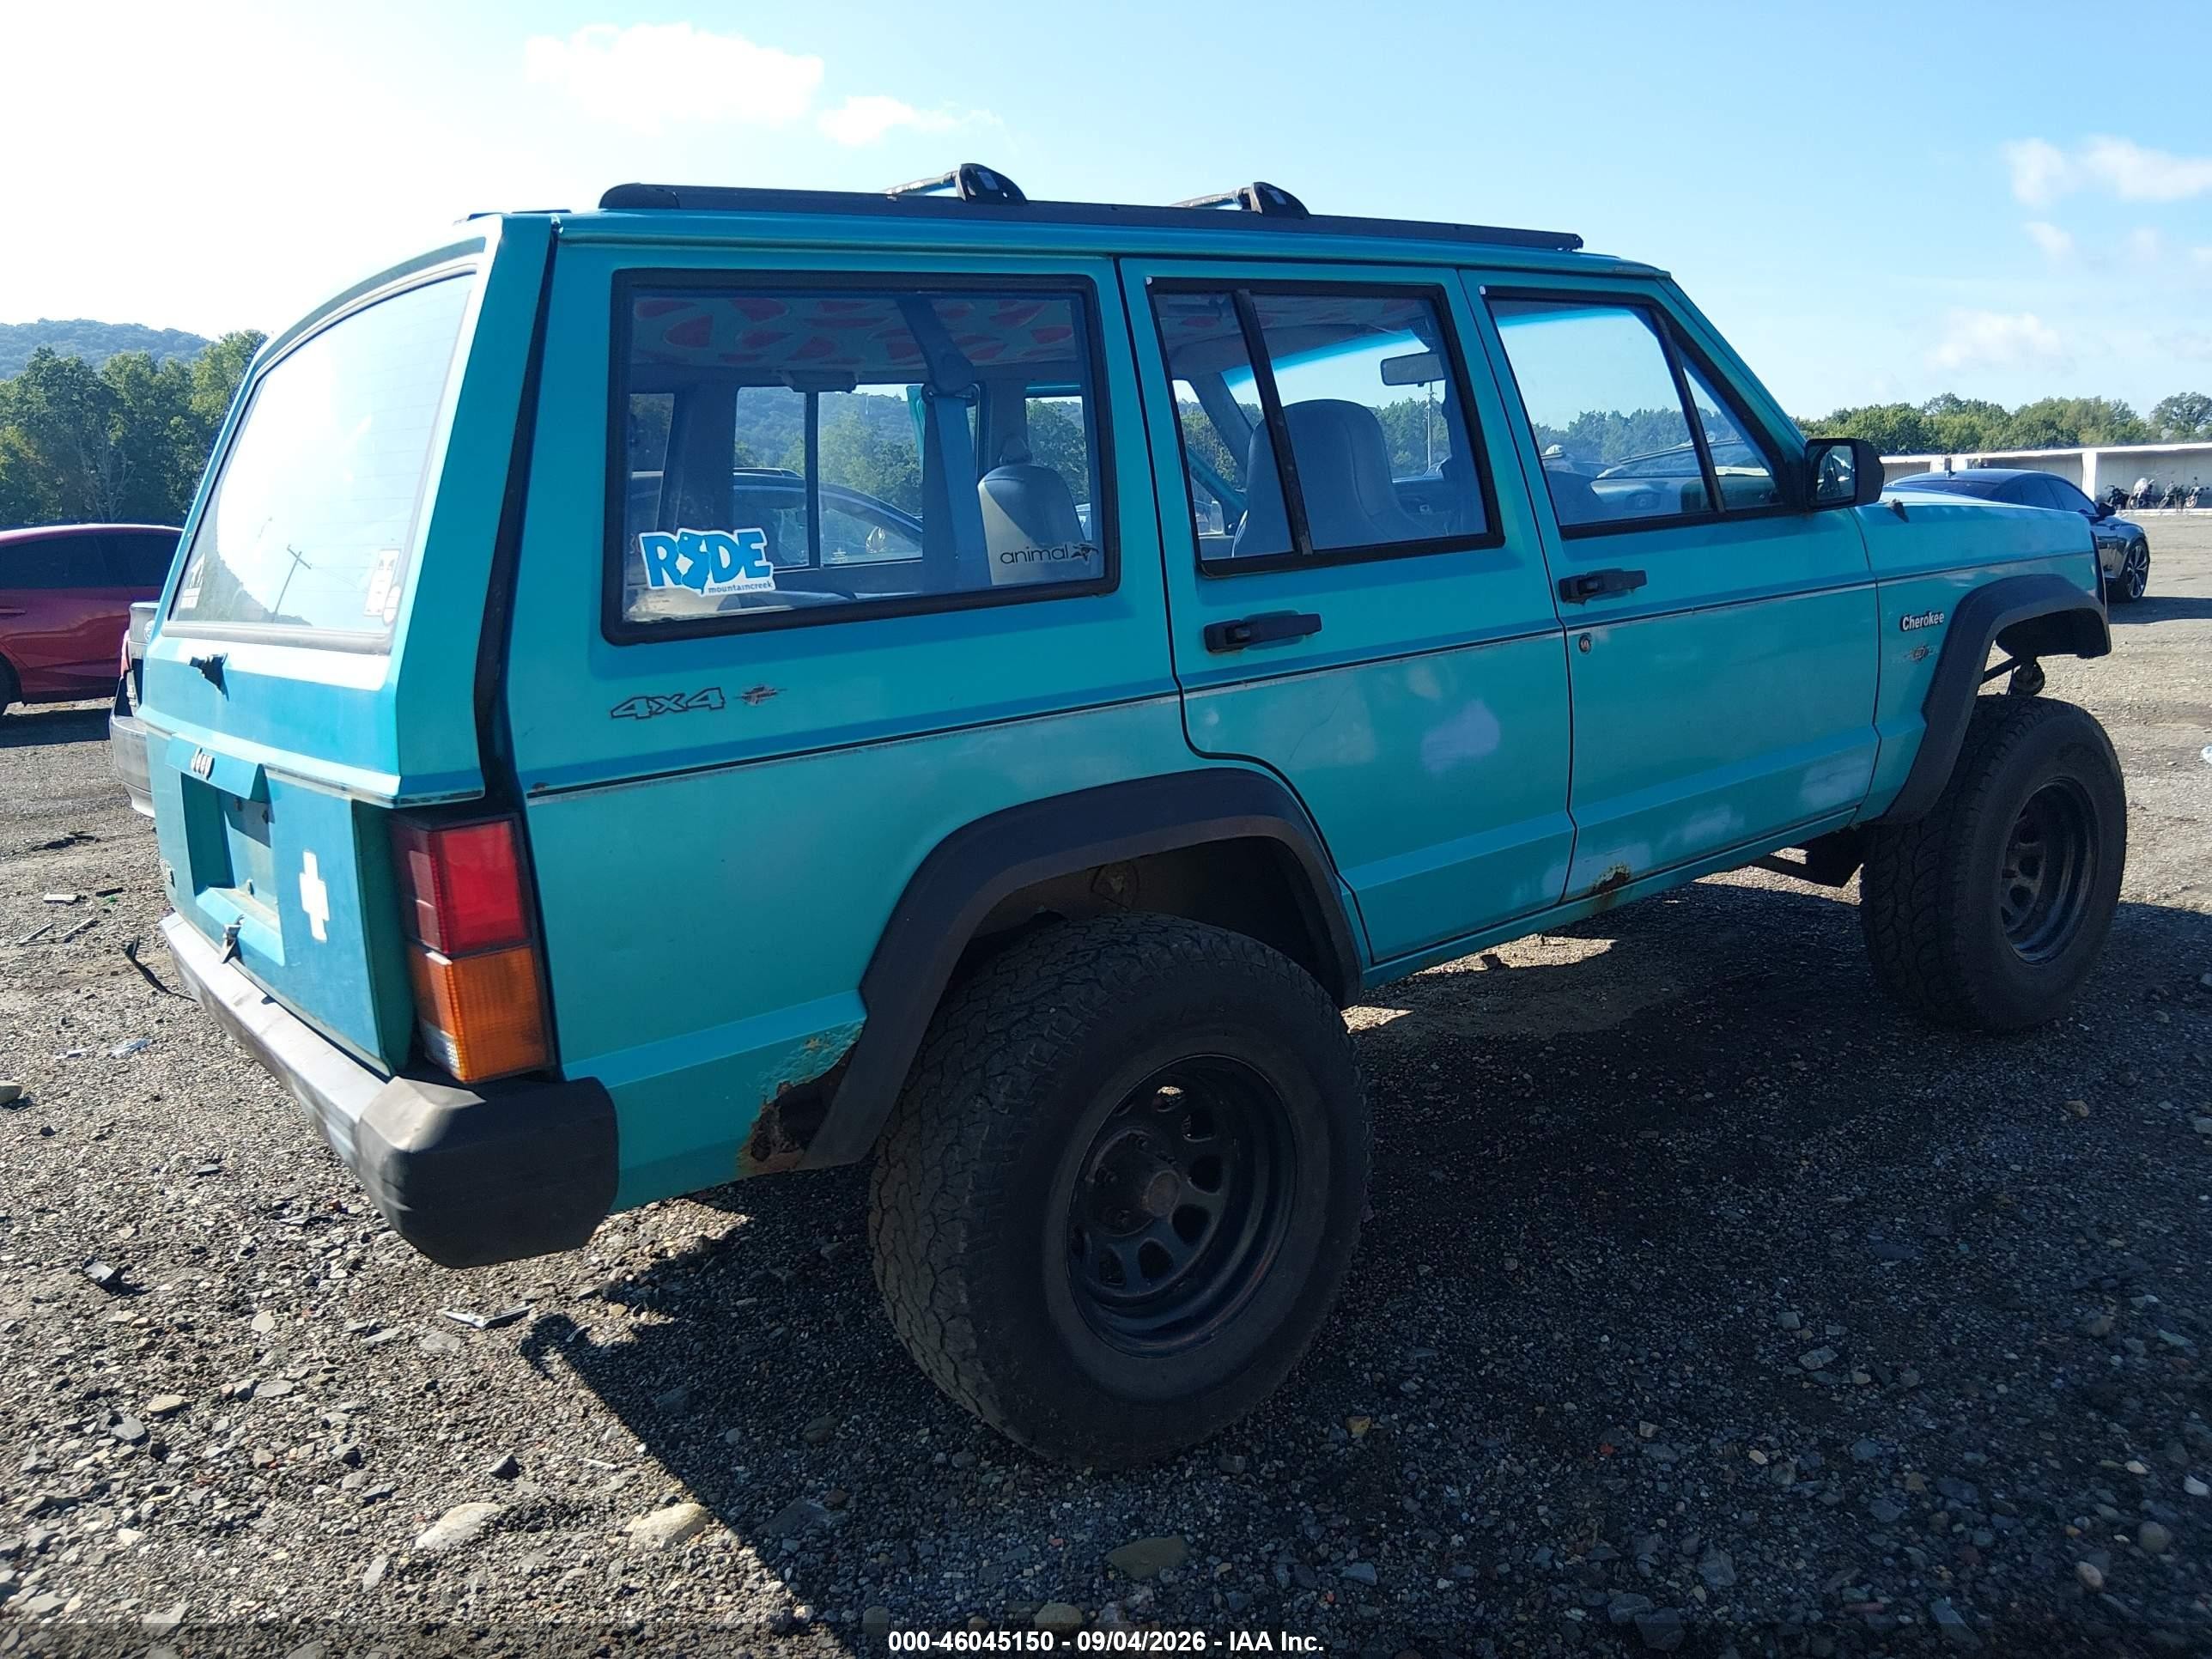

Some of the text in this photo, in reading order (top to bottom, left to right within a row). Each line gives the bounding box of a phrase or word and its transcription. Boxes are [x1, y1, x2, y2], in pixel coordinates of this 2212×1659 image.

[1000, 544, 1069, 564] animal
[708, 580, 774, 594] mountaincreek
[1901, 610, 1945, 631] Cherokee
